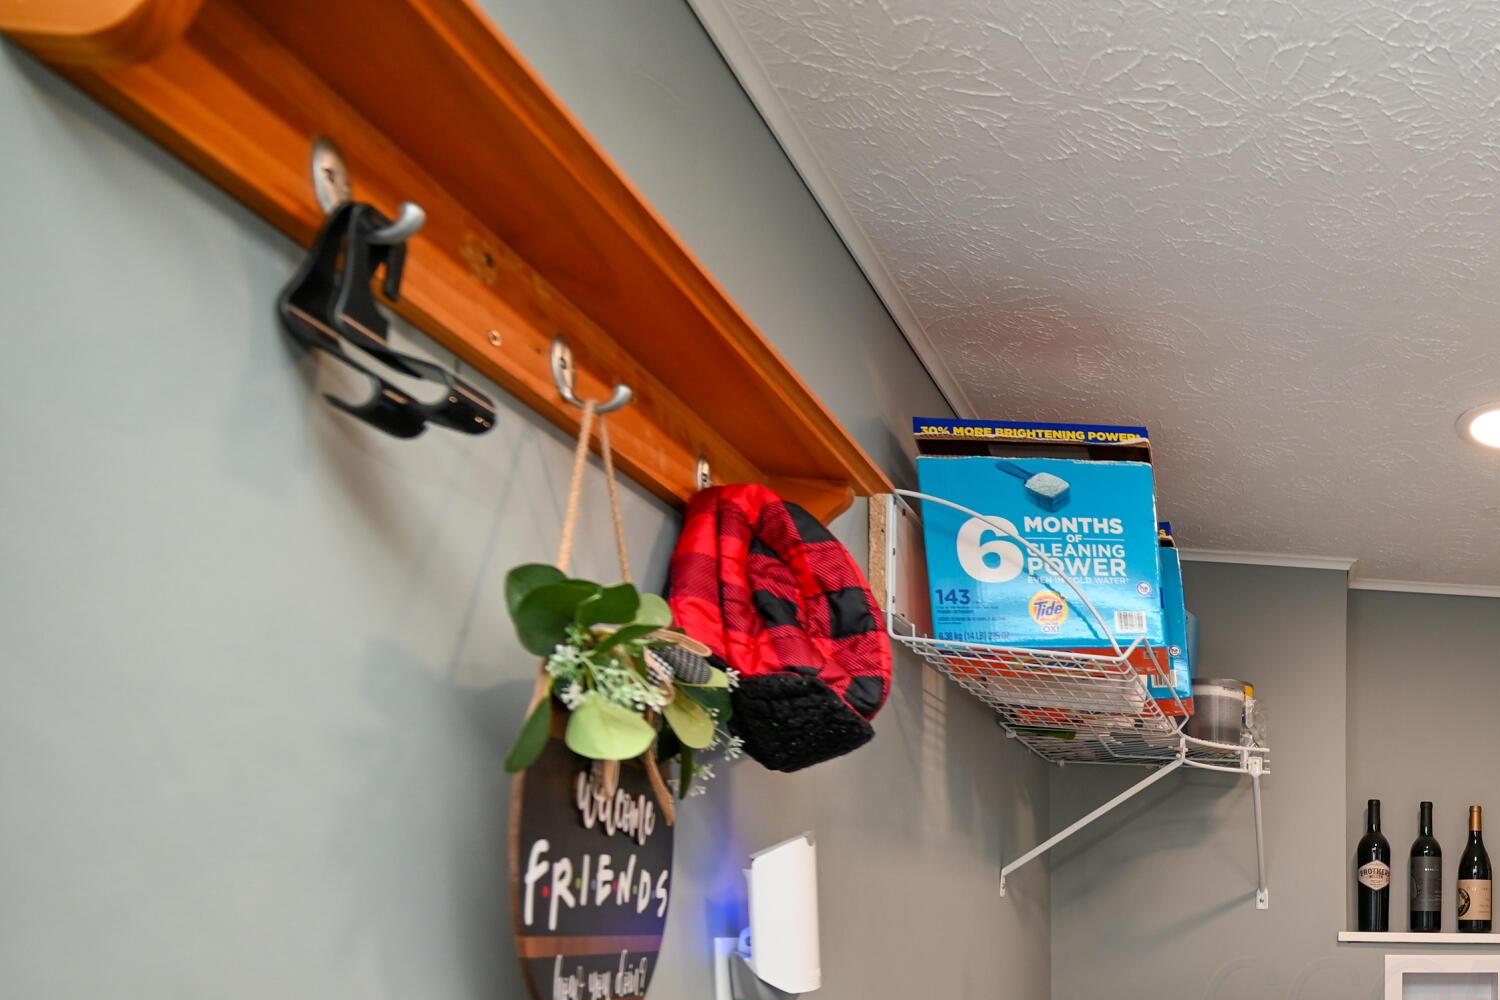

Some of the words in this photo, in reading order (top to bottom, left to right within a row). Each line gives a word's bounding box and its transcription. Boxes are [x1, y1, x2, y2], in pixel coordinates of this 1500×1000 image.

[952, 426, 992, 437] MORE
[994, 428, 1085, 440] BRIGHTENING
[1023, 516, 1124, 534] MONTHS
[1066, 534, 1083, 543] OF
[956, 515, 1024, 583] 6
[1026, 543, 1126, 558] CLEANING
[1027, 557, 1128, 577] POWER
[936, 589, 971, 605] 143
[1034, 601, 1063, 619] Tide
